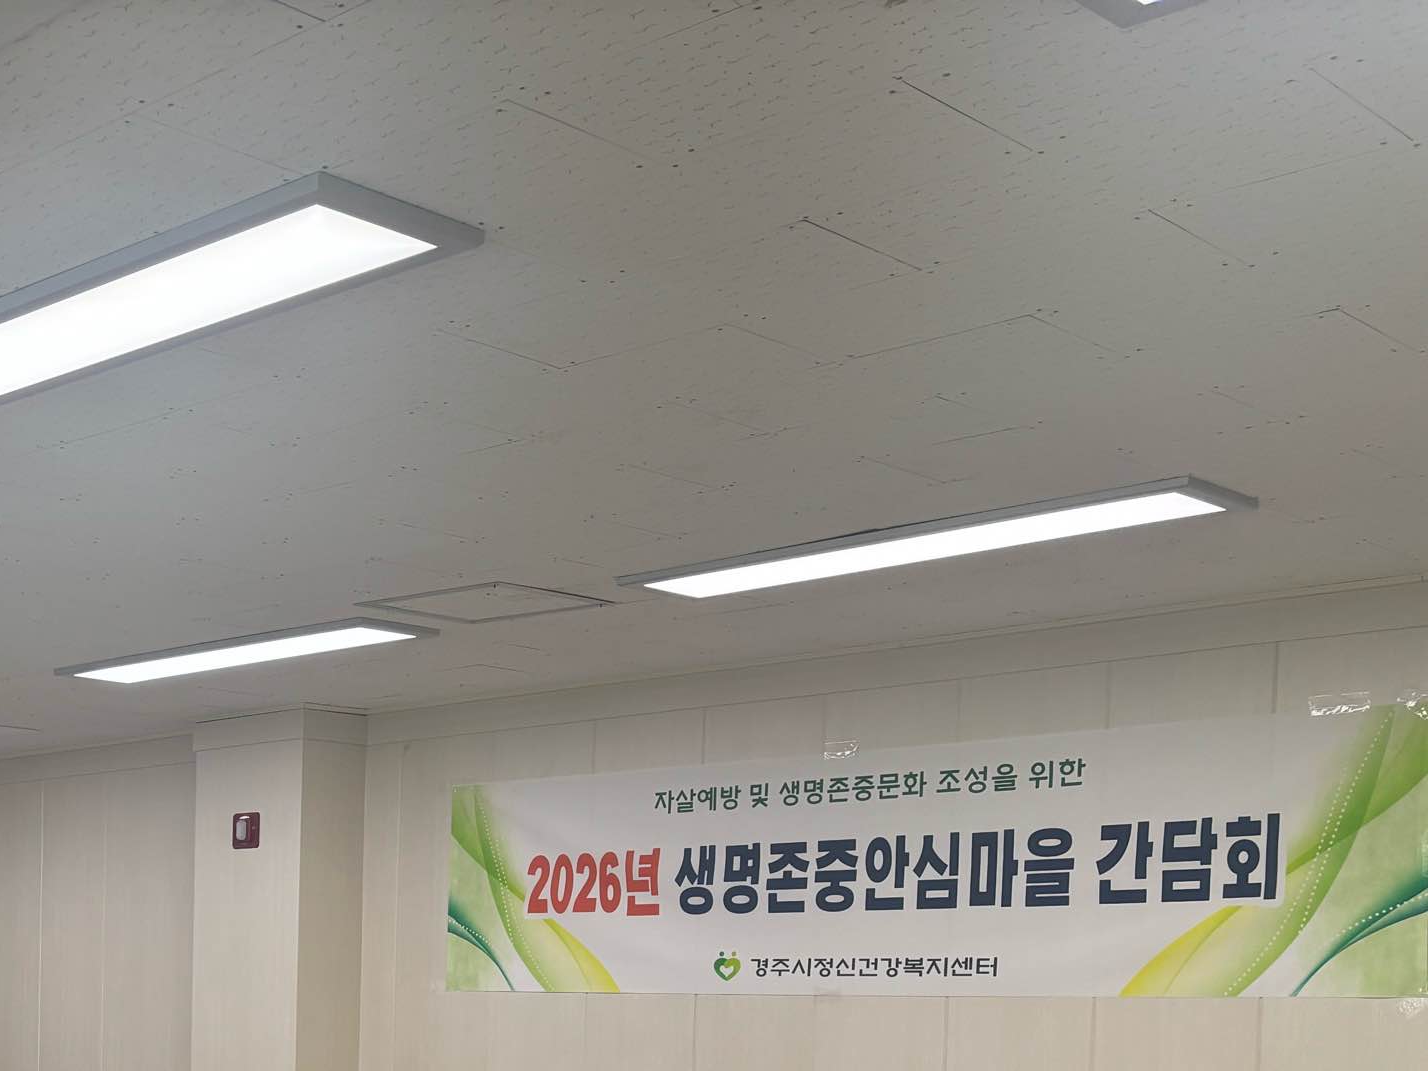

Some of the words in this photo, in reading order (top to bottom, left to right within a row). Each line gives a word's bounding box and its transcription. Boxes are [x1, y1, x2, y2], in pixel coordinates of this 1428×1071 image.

[653, 784, 742, 816] 자살예방
[750, 782, 769, 808] 및
[779, 770, 926, 806] 생명존중문화
[936, 762, 1018, 794] 조성을
[1029, 755, 1086, 789] 위한
[527, 847, 661, 917] 2026년
[675, 827, 1074, 915] 생명존중안심마을
[1096, 813, 1280, 905] 간담회
[750, 955, 998, 978] 경주시정신건강복지센터
